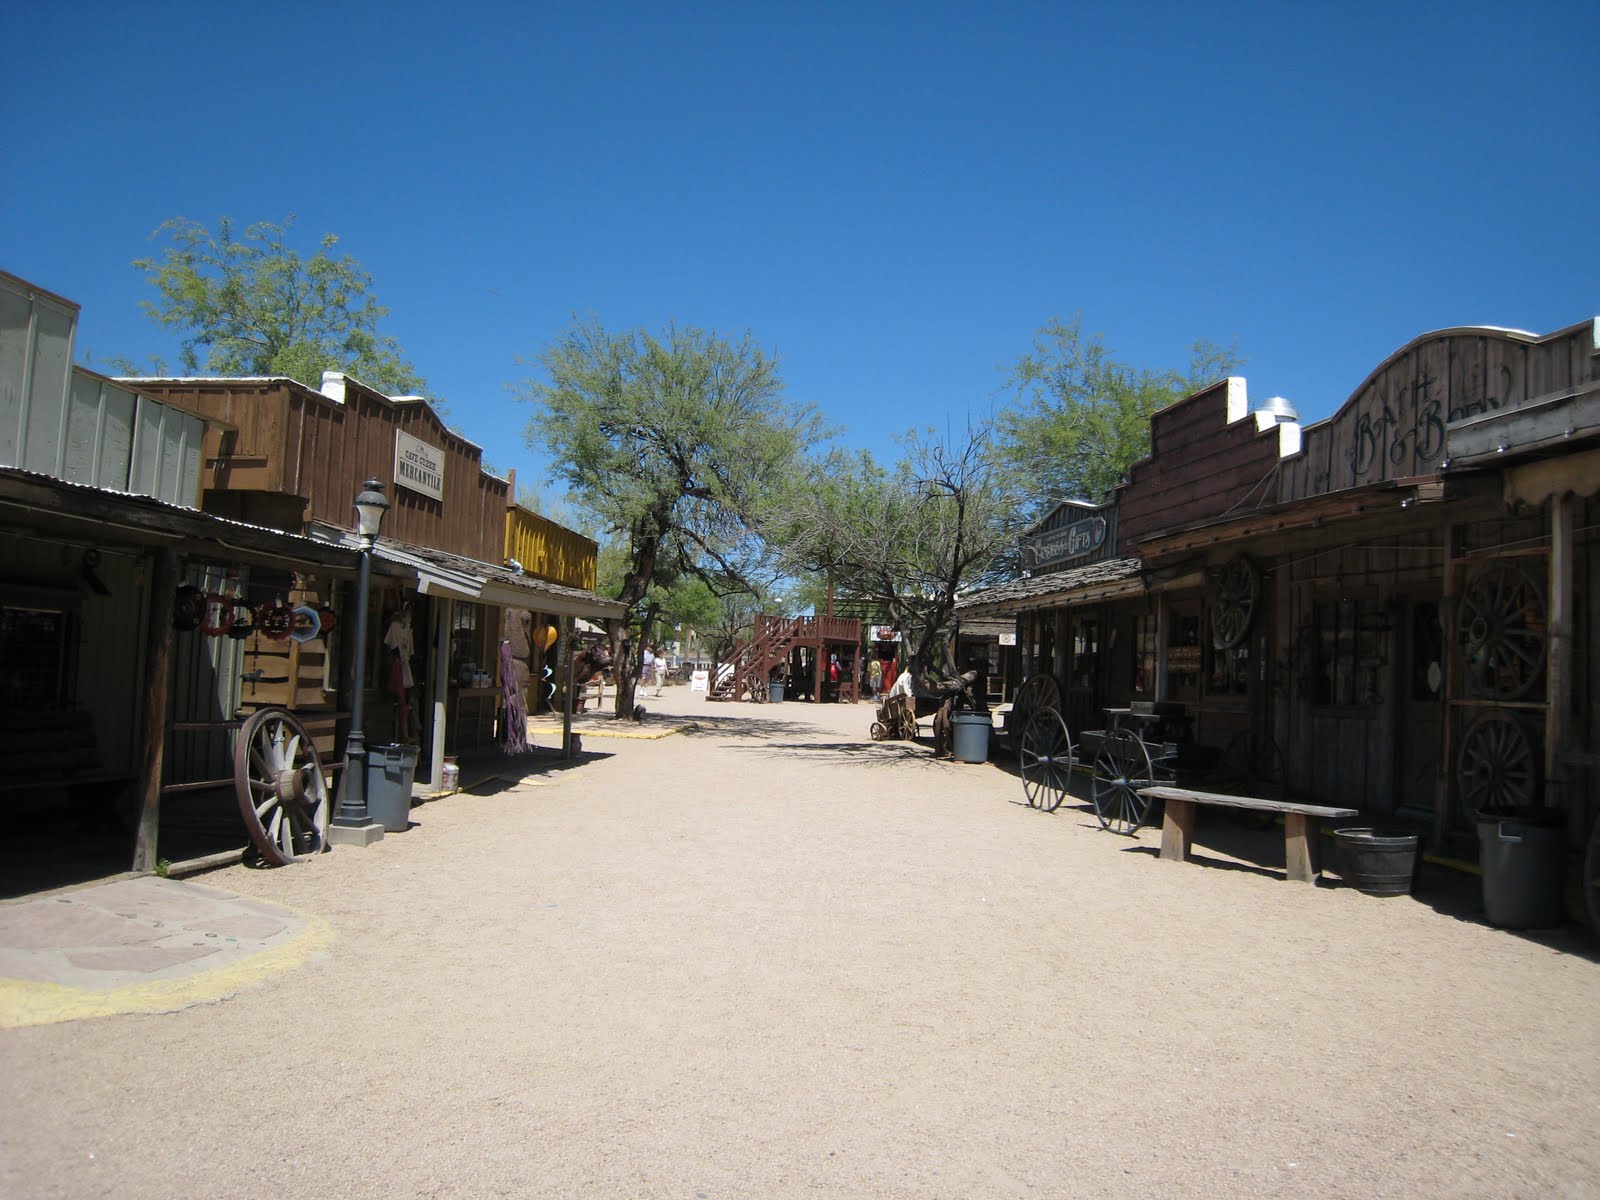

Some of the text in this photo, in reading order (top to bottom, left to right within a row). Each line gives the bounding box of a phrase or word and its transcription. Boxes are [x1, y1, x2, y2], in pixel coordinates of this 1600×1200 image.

[1346, 371, 1437, 475] BATH
[1390, 428, 1417, 464] &
[400, 462, 441, 491] MERCANTILE
